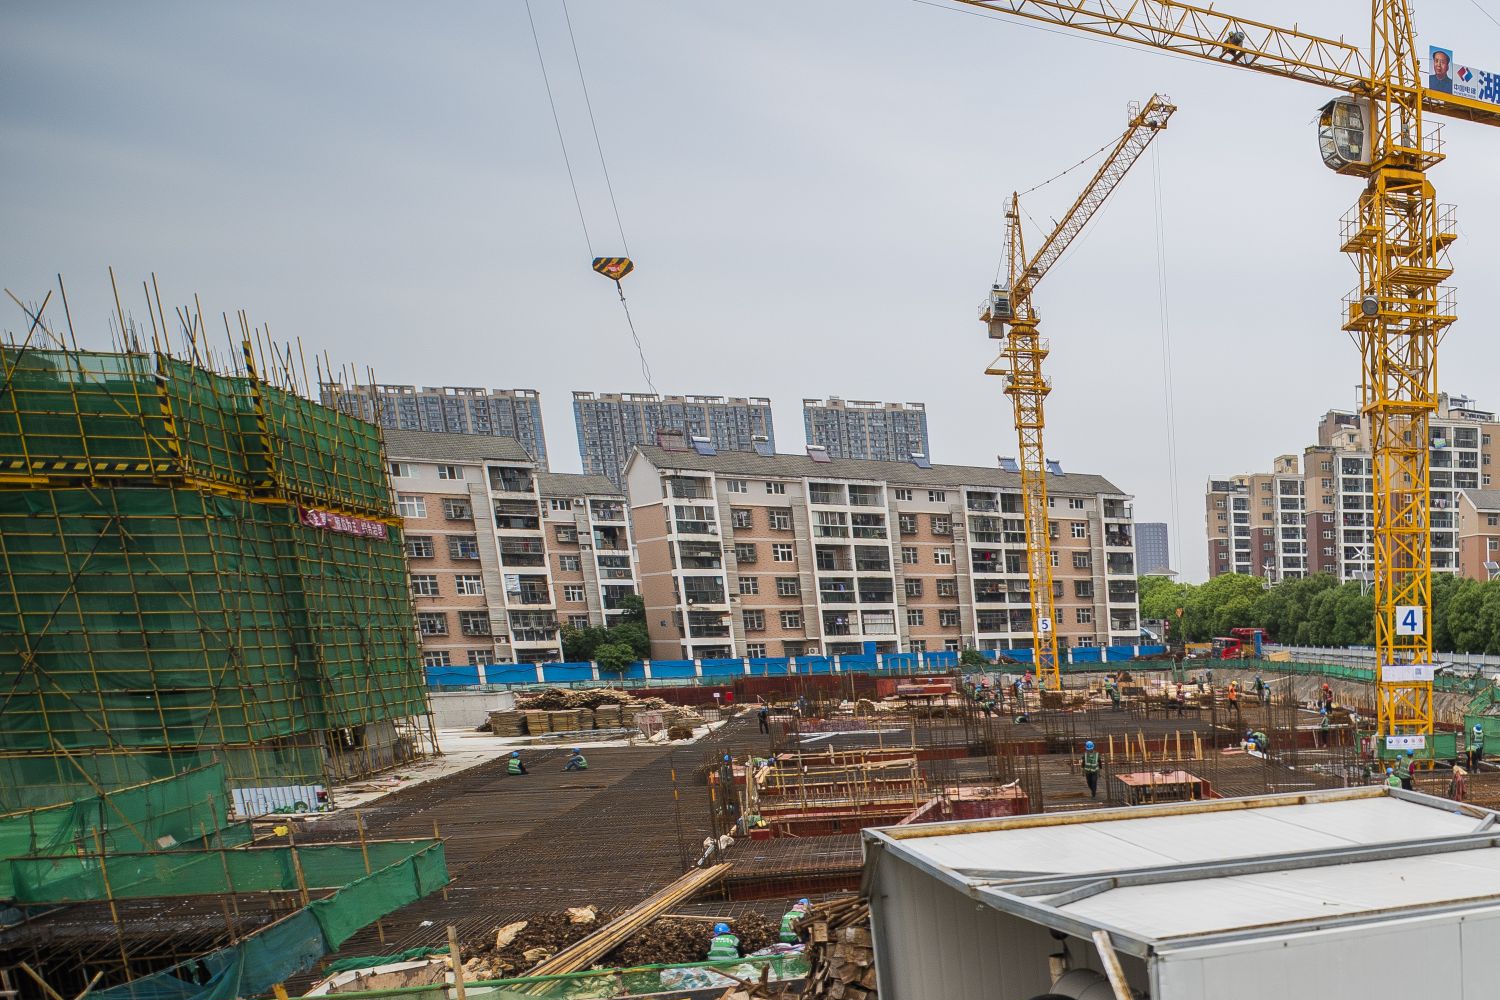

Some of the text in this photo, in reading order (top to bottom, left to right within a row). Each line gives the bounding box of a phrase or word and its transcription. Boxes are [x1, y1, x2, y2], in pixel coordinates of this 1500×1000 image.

[1453, 83, 1477, 95] 中国电建
[1041, 619, 1049, 630] 5
[1402, 609, 1418, 632] 4
